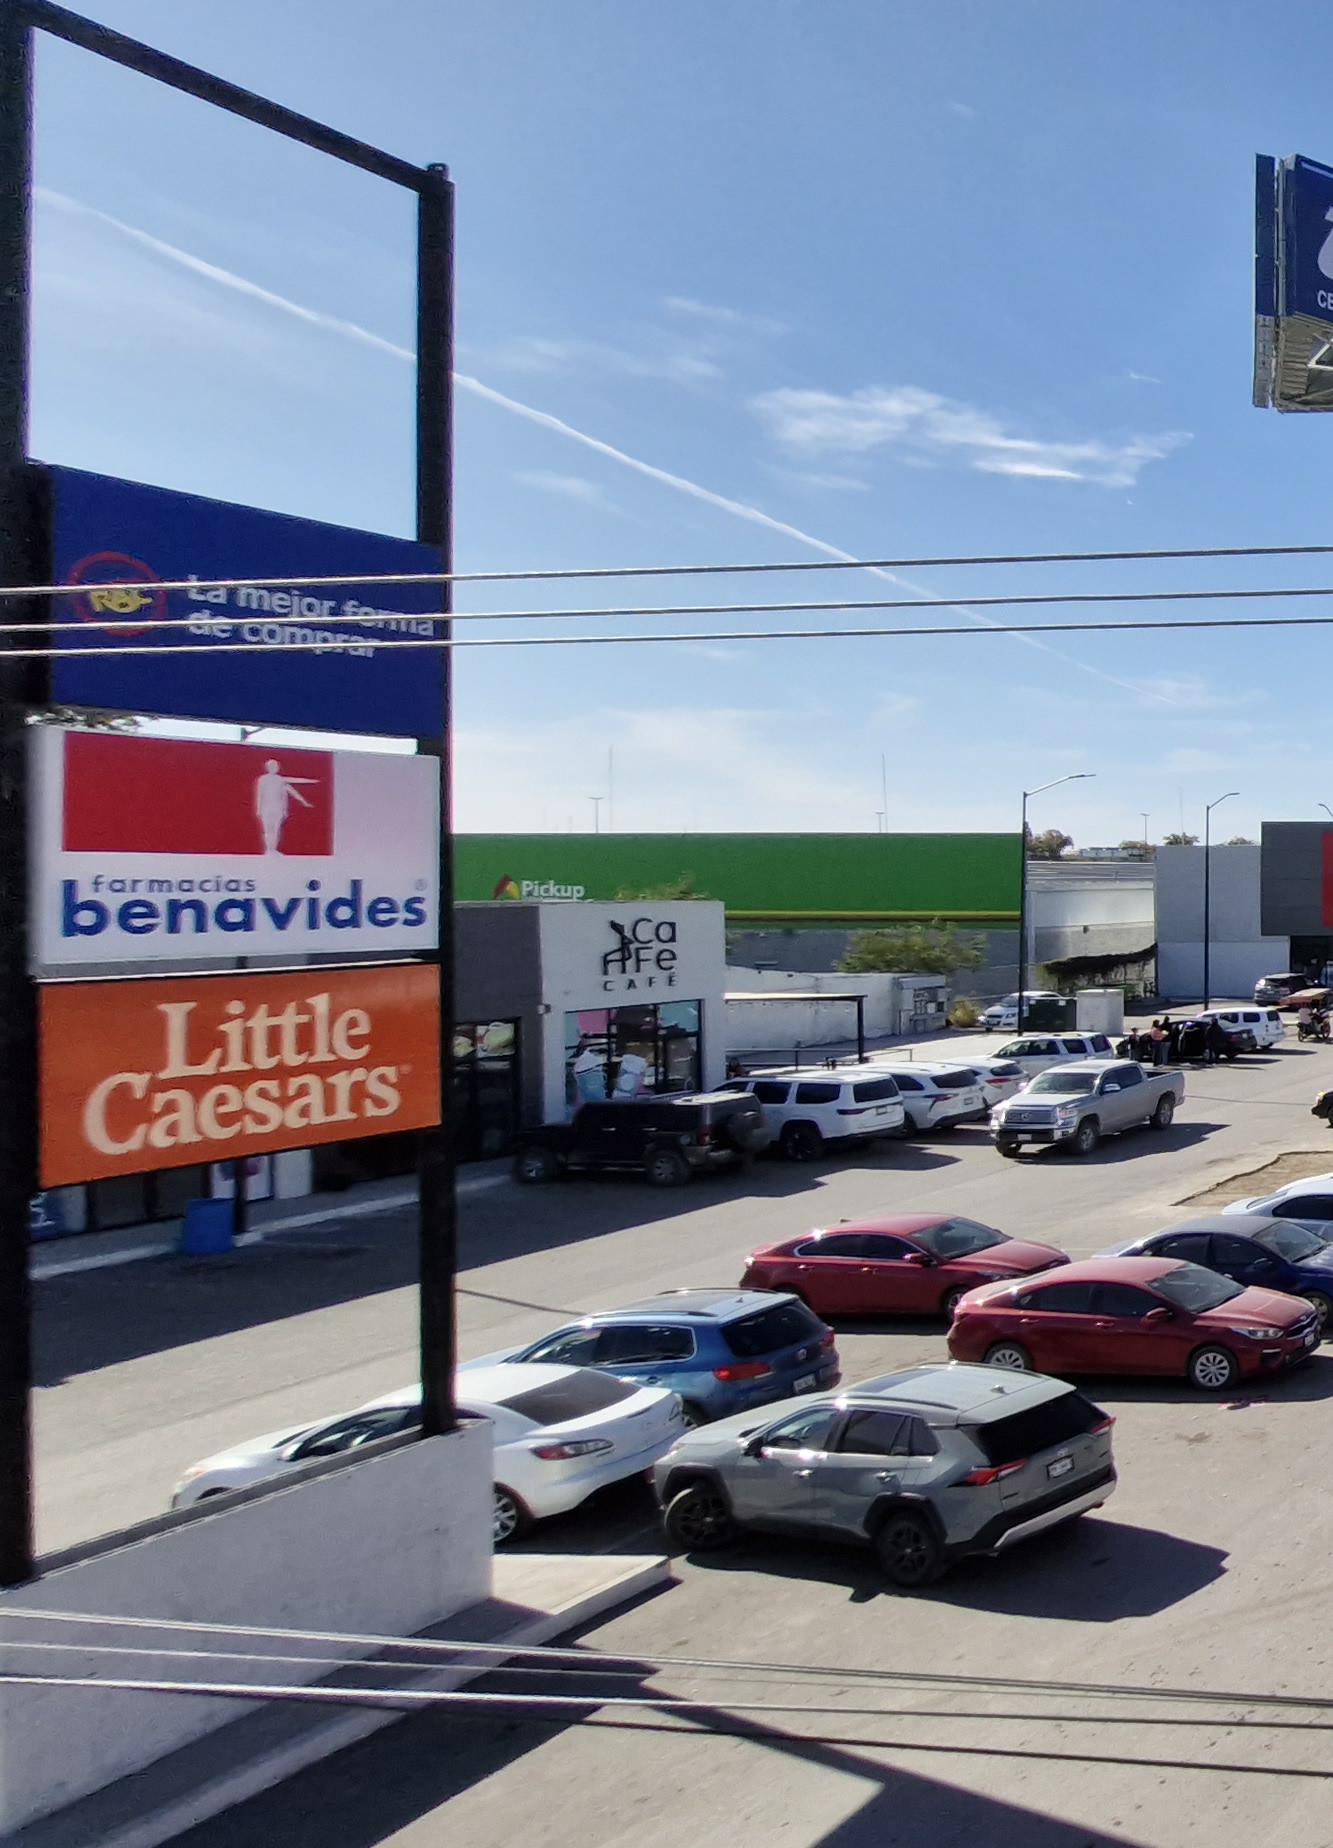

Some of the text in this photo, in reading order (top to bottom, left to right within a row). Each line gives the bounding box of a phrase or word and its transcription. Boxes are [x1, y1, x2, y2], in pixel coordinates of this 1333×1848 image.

[187, 574, 228, 605] La
[236, 585, 337, 619] mejor
[187, 609, 233, 639] de
[91, 873, 257, 894] farmacias
[521, 879, 585, 900] Pickup
[60, 878, 428, 938] benavides
[157, 992, 373, 1080] Little
[83, 1064, 402, 1157] Caesars
